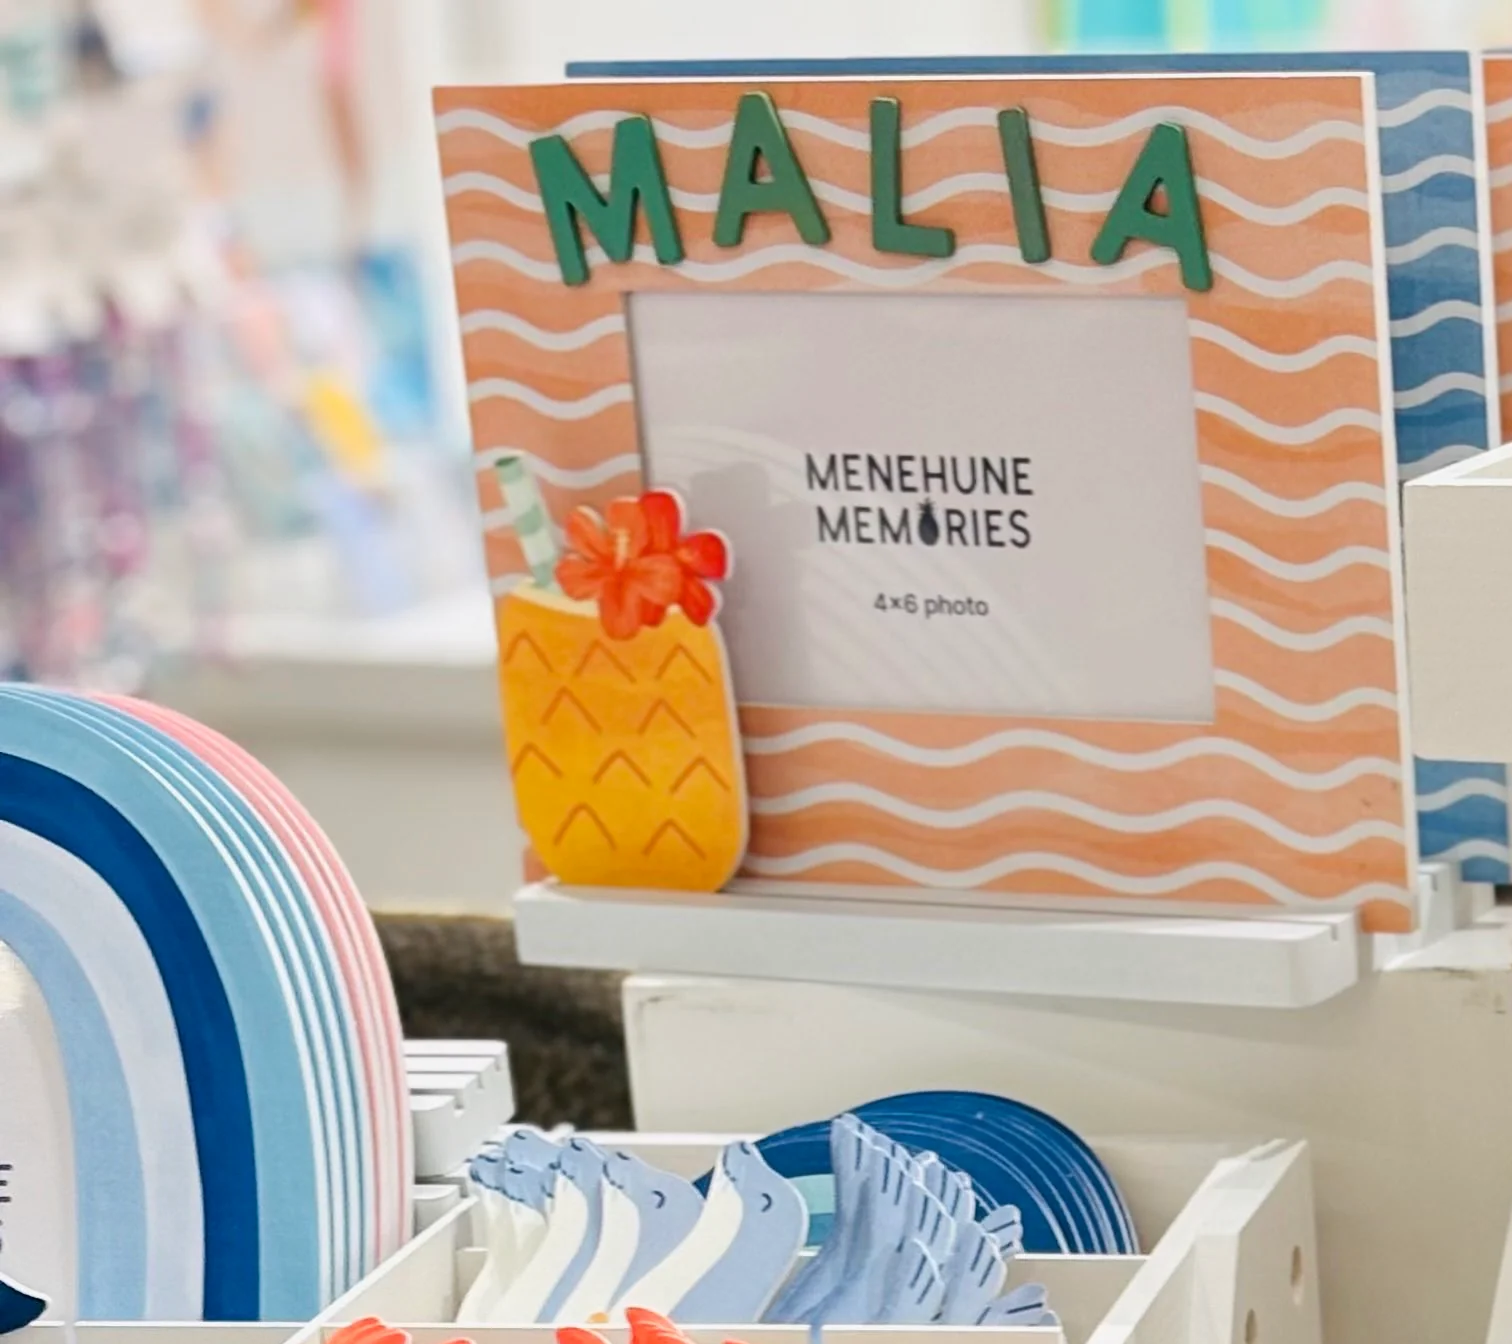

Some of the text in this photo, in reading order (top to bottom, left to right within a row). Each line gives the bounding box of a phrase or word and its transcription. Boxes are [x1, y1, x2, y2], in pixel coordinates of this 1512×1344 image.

[531, 90, 1211, 291] MALIA
[805, 453, 1034, 496] MENEHUNE
[924, 594, 990, 619] photo
